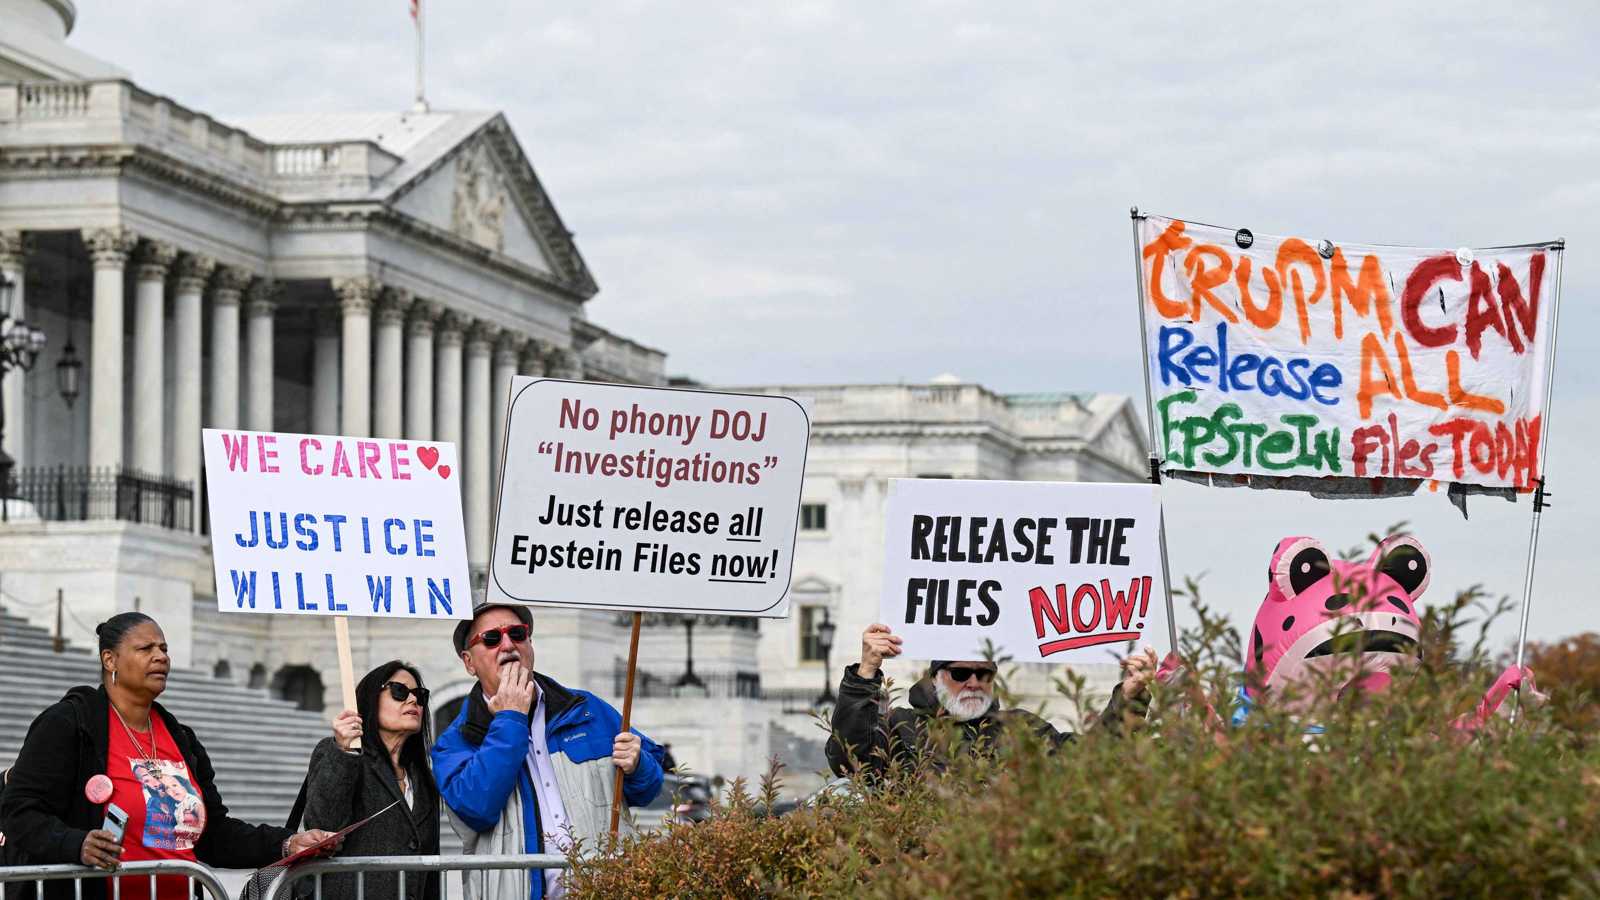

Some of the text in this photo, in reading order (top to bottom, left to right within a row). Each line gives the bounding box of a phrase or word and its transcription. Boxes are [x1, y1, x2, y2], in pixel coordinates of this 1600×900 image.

[1401, 250, 1545, 361] CAN
[1158, 321, 1504, 420] Release ALL
[559, 398, 767, 446] No phony DOJ
[221, 434, 412, 480] WE CARE
[538, 442, 778, 488] “Investigations”
[235, 510, 436, 557] JUSTICE
[538, 495, 763, 537] Just release all
[510, 534, 779, 579] Epstein Files now!
[910, 514, 1136, 566] RELEASE THE
[230, 569, 453, 615] WILL WIN
[905, 576, 1153, 639] FILES NOW!
